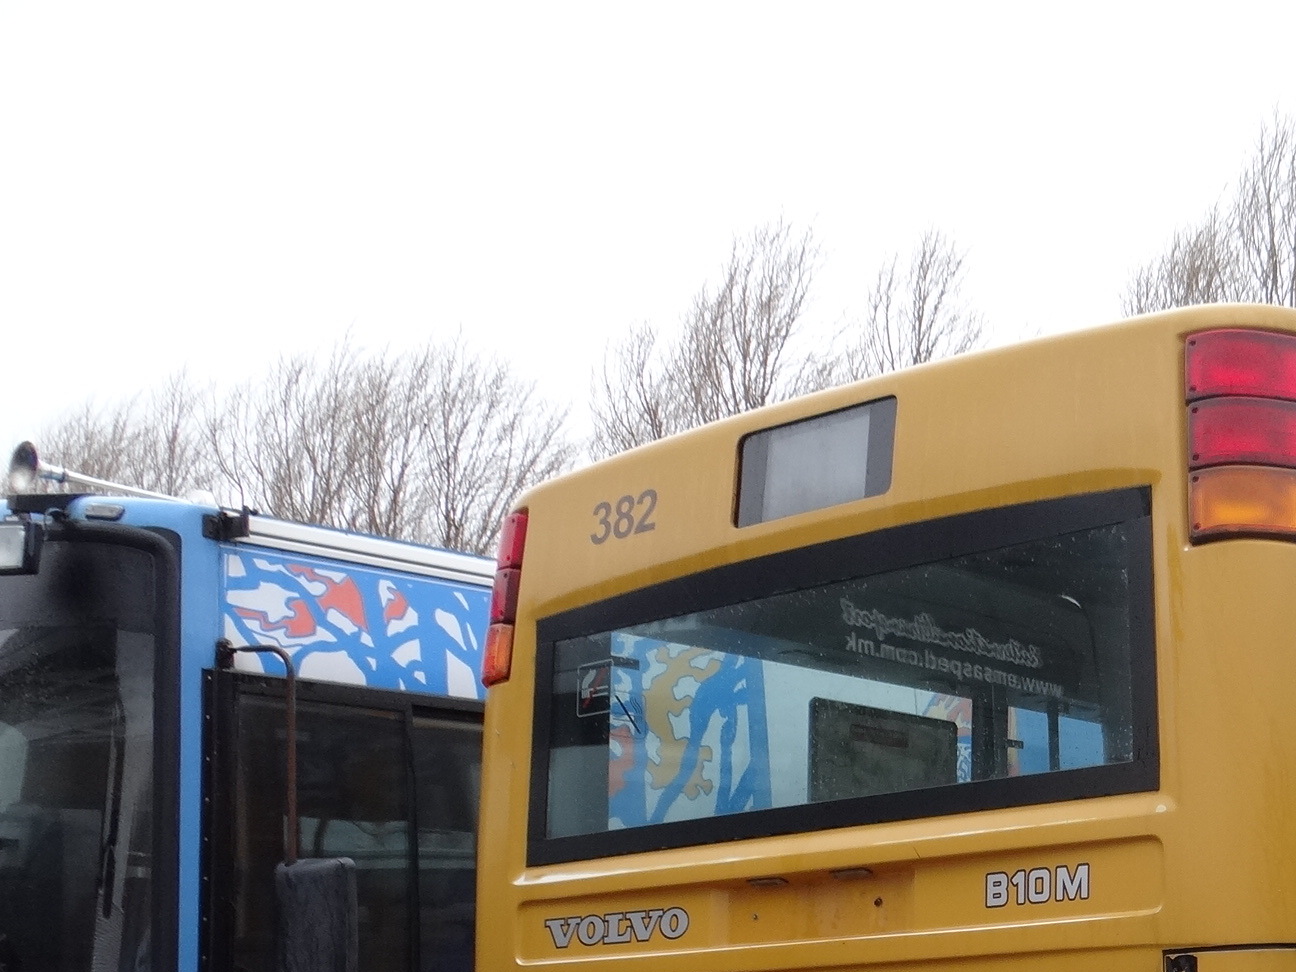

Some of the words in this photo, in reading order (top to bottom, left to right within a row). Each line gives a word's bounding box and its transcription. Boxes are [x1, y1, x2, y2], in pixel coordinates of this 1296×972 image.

[590, 489, 657, 545] 382
[984, 863, 1091, 908] B10M
[545, 907, 690, 948] VOLVO
